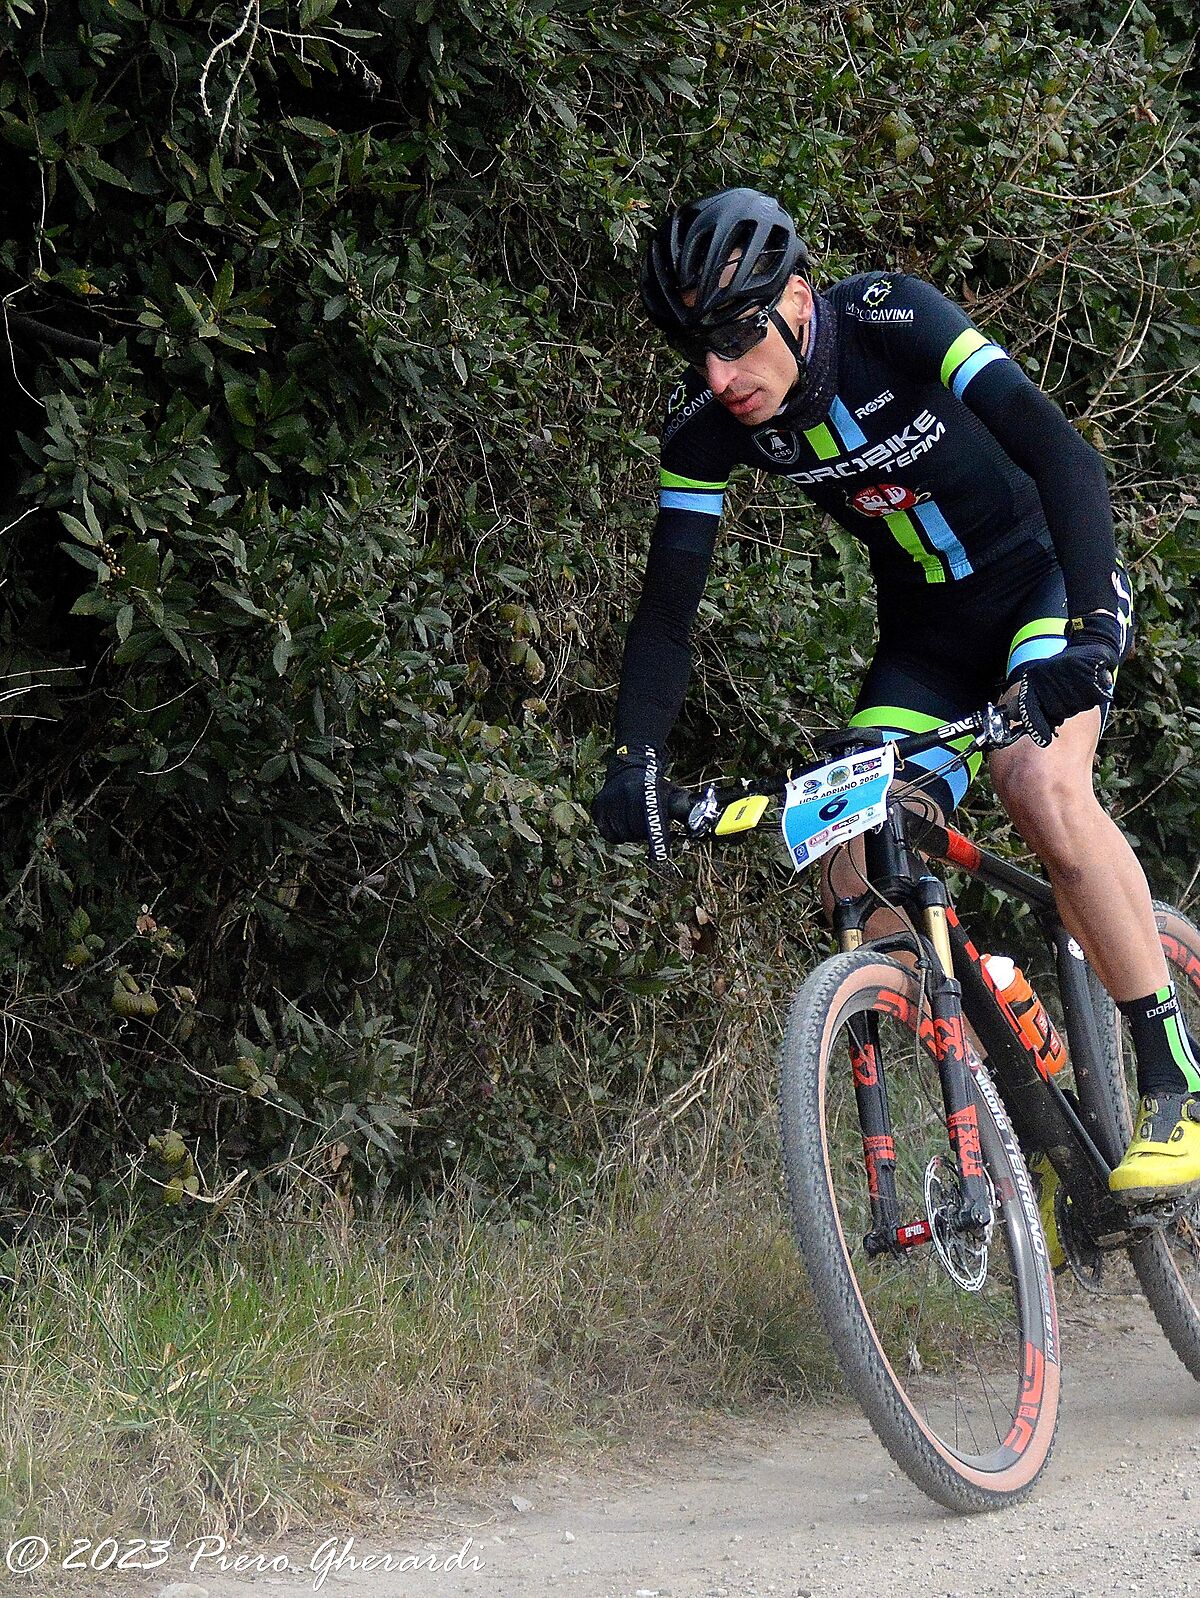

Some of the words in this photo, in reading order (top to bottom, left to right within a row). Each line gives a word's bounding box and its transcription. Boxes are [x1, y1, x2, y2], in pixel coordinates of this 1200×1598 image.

[662, 389, 714, 446] ARCOCAVIN
[879, 421, 947, 473] TEAM
[799, 795, 819, 805] LIDO
[820, 781, 858, 799] ADRIANO
[859, 772, 880, 785] 2020
[818, 792, 849, 822] 6
[958, 1127, 983, 1178] FOX
[1003, 1138, 1046, 1256] TERRENO
